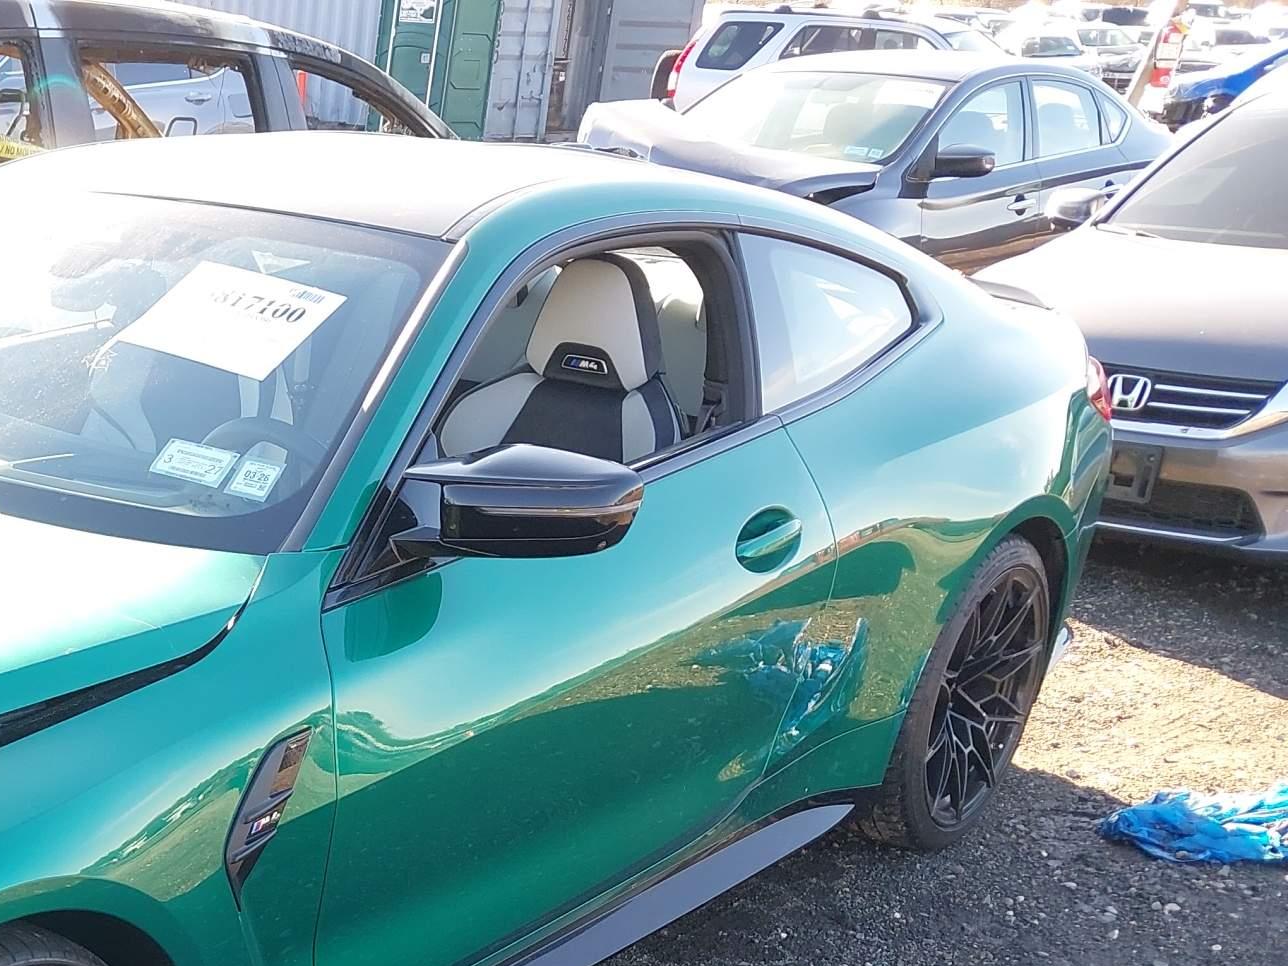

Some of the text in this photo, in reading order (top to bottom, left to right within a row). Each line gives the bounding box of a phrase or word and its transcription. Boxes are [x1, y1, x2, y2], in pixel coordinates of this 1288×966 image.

[5, 143, 16, 155] NO
[162, 454, 174, 465] 3
[204, 464, 224, 476] 27
[243, 470, 257, 479] 03
[257, 473, 271, 481] 26
